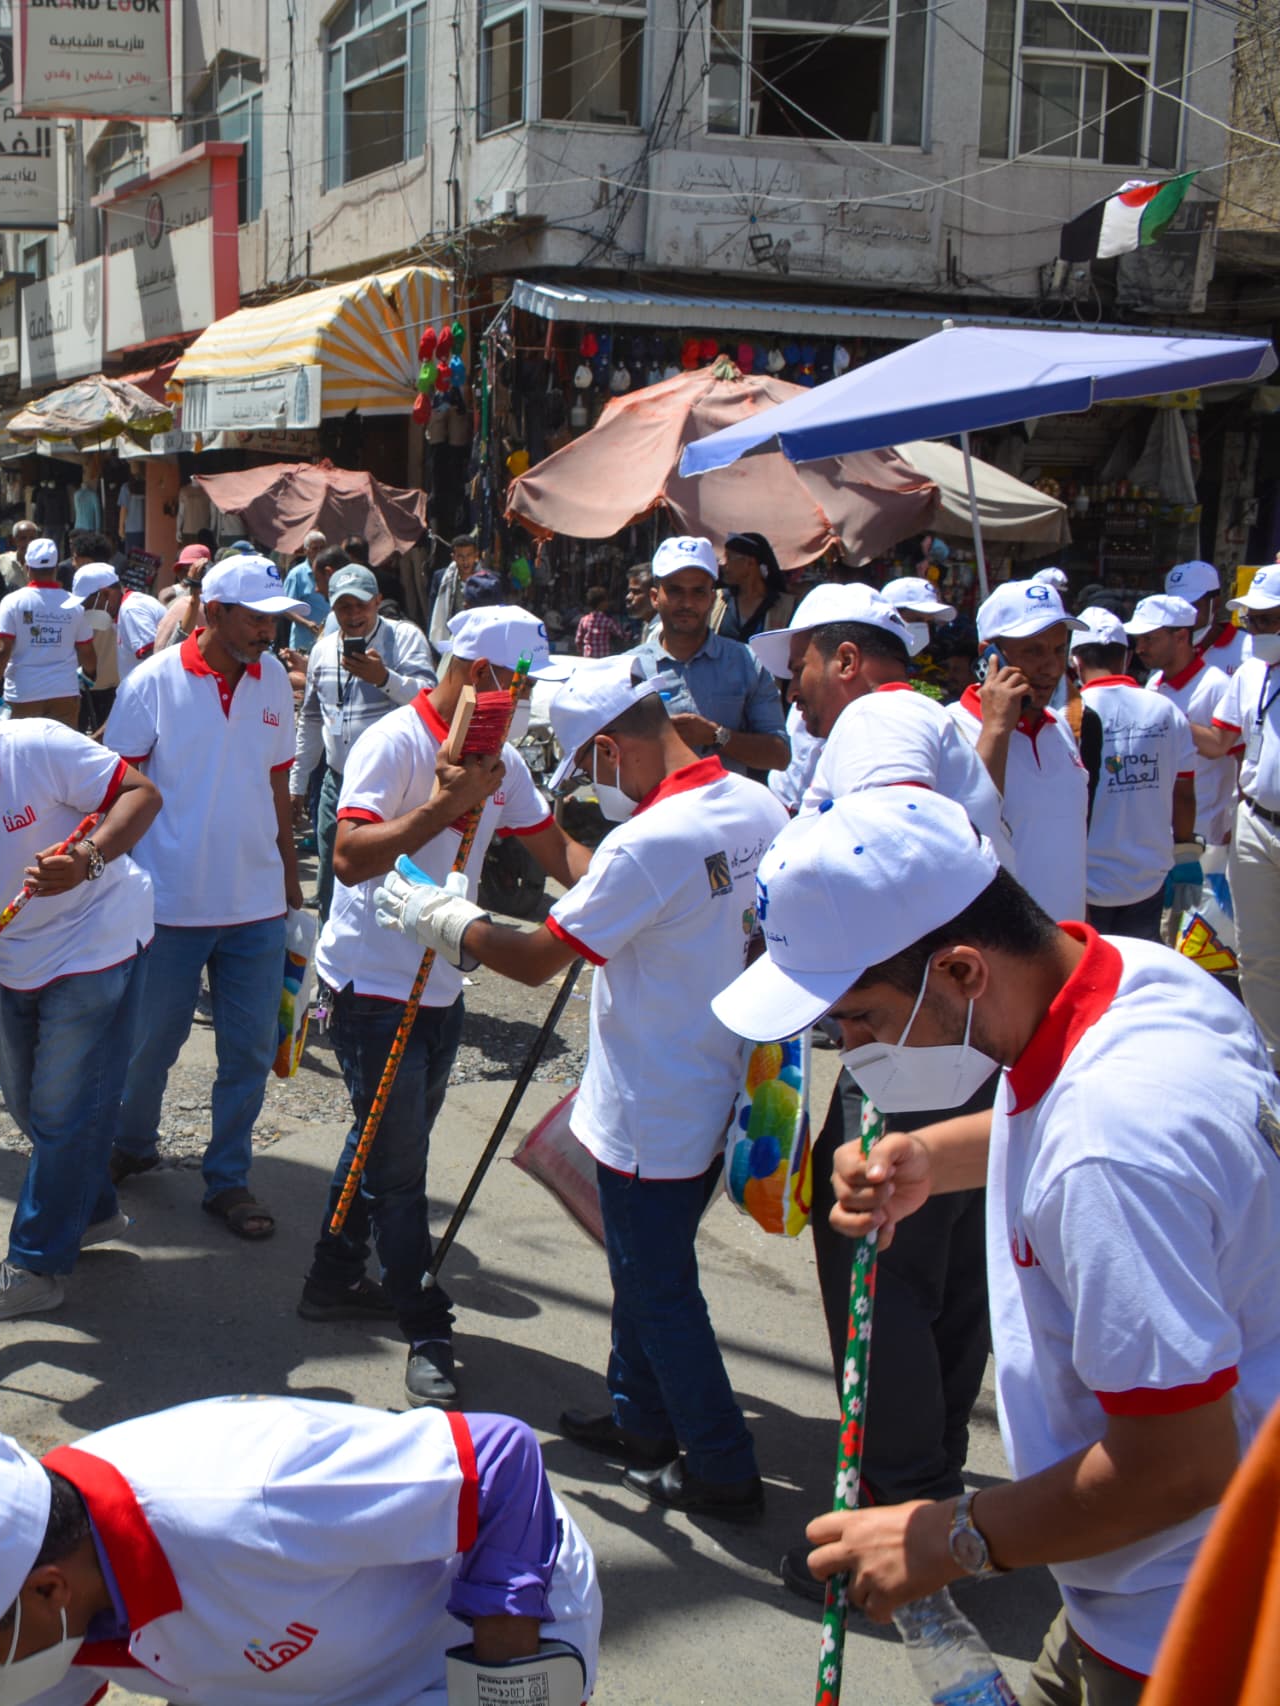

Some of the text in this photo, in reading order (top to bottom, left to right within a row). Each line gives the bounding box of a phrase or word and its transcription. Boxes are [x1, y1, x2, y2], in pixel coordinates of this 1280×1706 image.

[49, 32, 104, 49] الشبابية
[29, 290, 73, 340] الفخامة
[1123, 752, 1159, 766] يوم
[1107, 764, 1160, 787] العطاء
[2, 804, 37, 833] الهنا
[243, 1621, 320, 1674] الهنا
